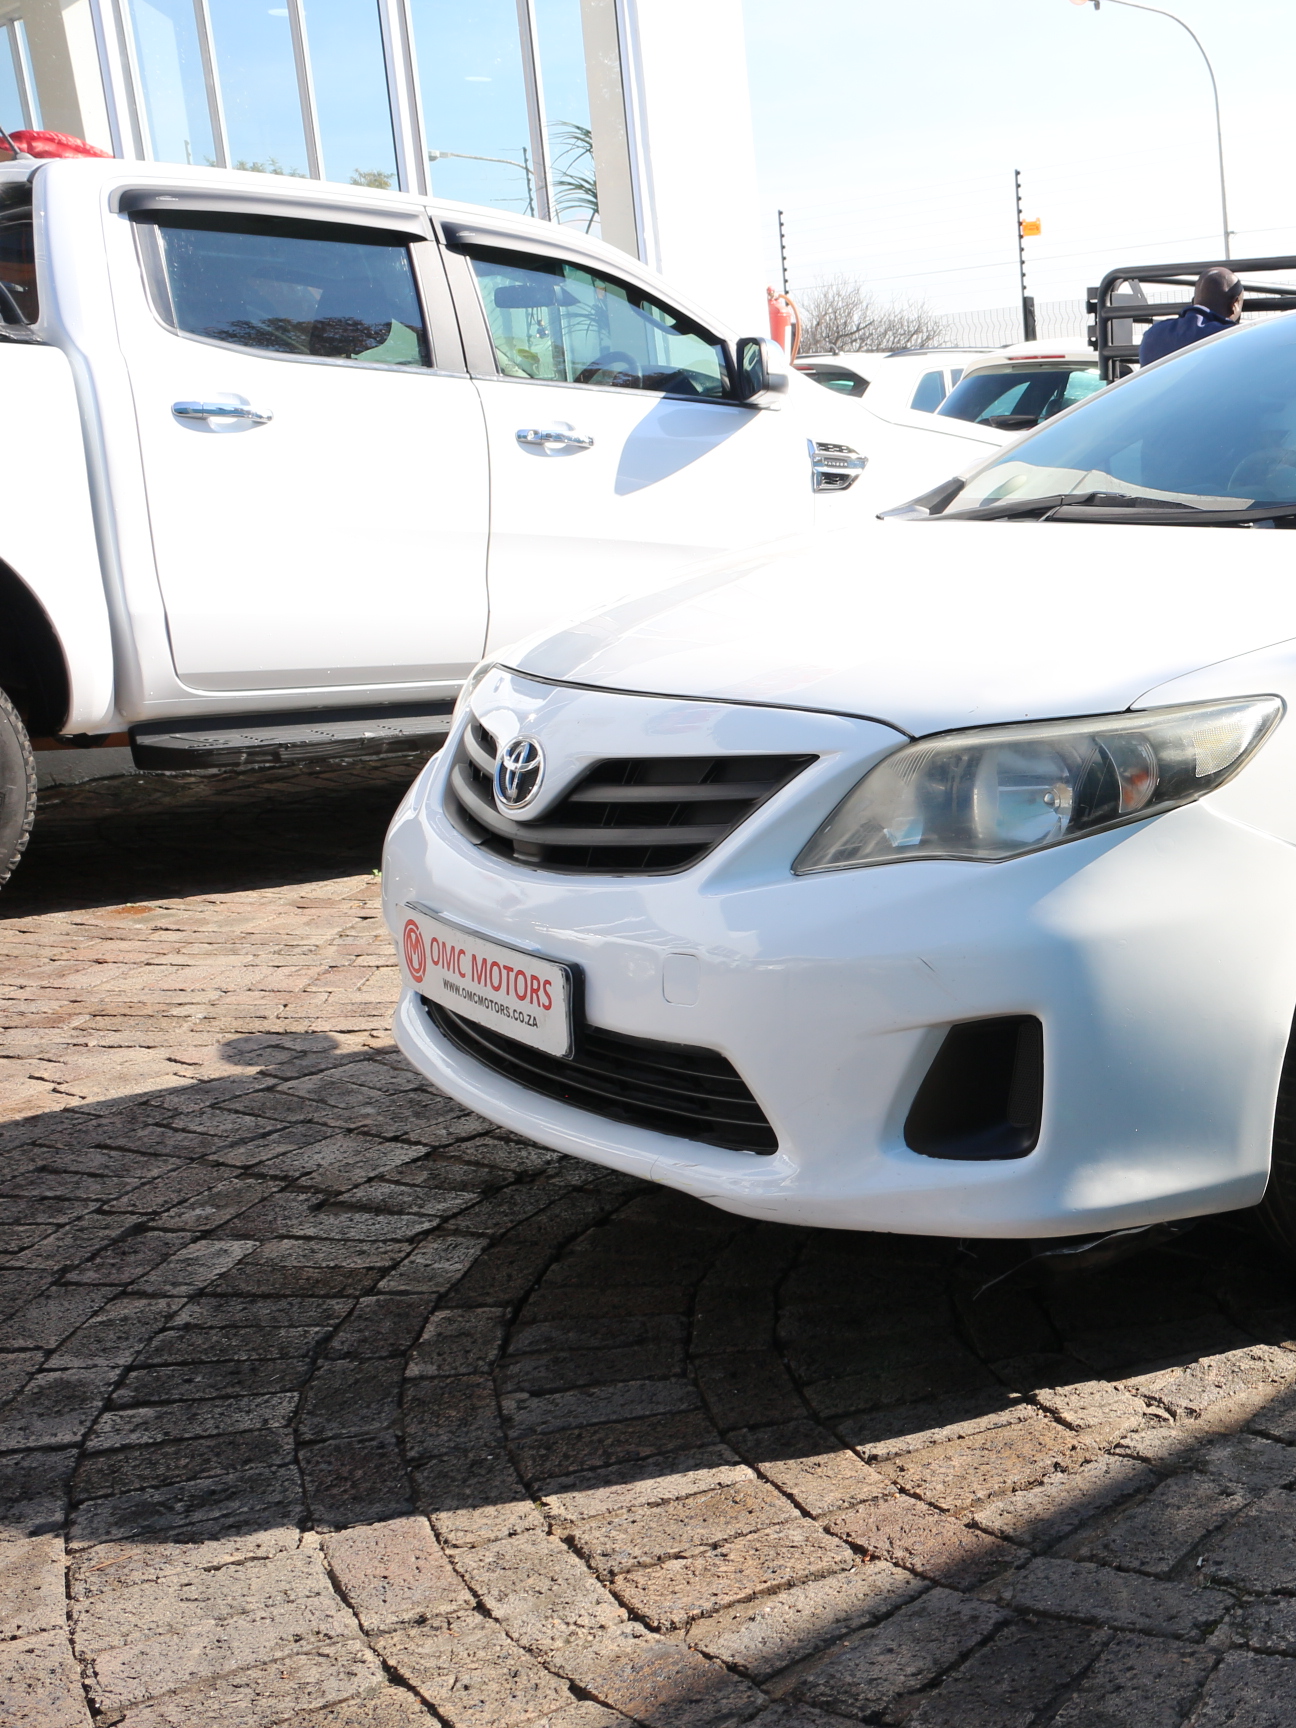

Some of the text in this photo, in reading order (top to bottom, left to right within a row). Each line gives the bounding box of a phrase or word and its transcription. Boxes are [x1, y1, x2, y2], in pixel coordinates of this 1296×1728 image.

[430, 937, 553, 1011] OMC MOTORS
[443, 977, 539, 1029] WWW.OMCMOTORS.CO.ZA
